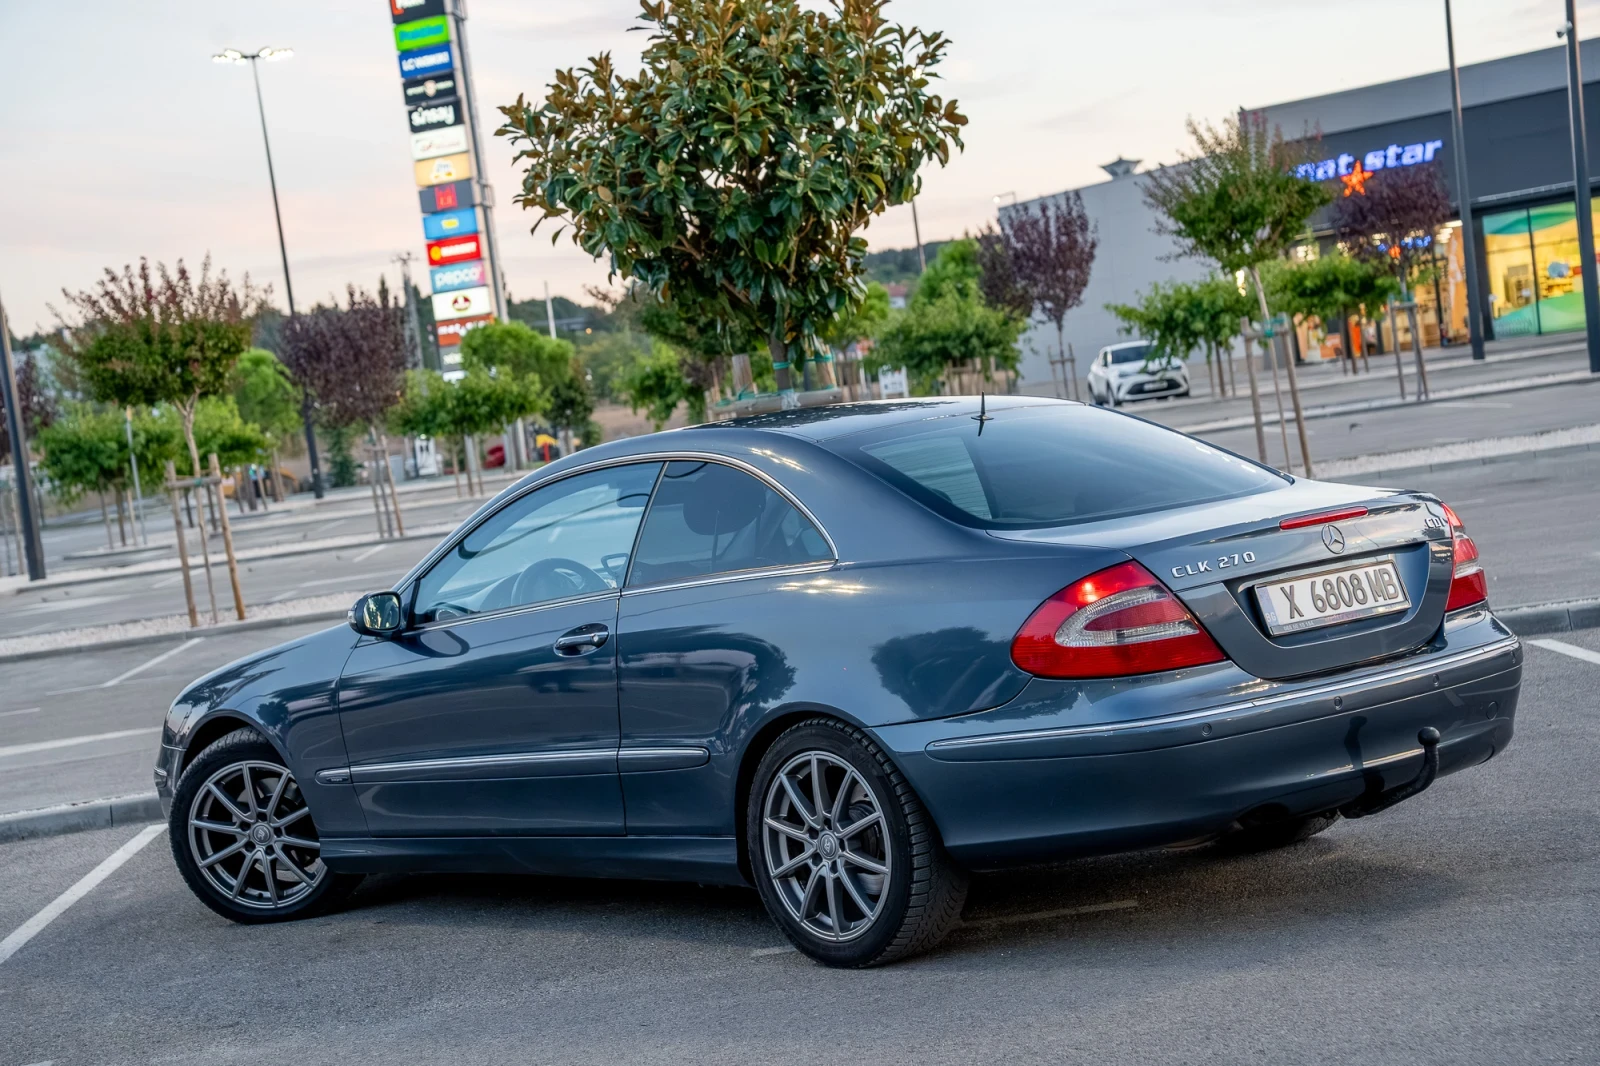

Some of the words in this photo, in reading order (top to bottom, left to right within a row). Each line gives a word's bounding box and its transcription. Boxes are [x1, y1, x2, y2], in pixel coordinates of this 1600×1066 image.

[1364, 139, 1443, 172] star
[434, 266, 481, 289] pepco
[1425, 517, 1446, 528] CDI
[1171, 560, 1212, 578] CLK
[1217, 551, 1256, 569] 270
[1280, 584, 1304, 619] X
[1310, 573, 1368, 613] 6808
[1364, 567, 1399, 602] MB
[1265, 612, 1277, 623] BG
